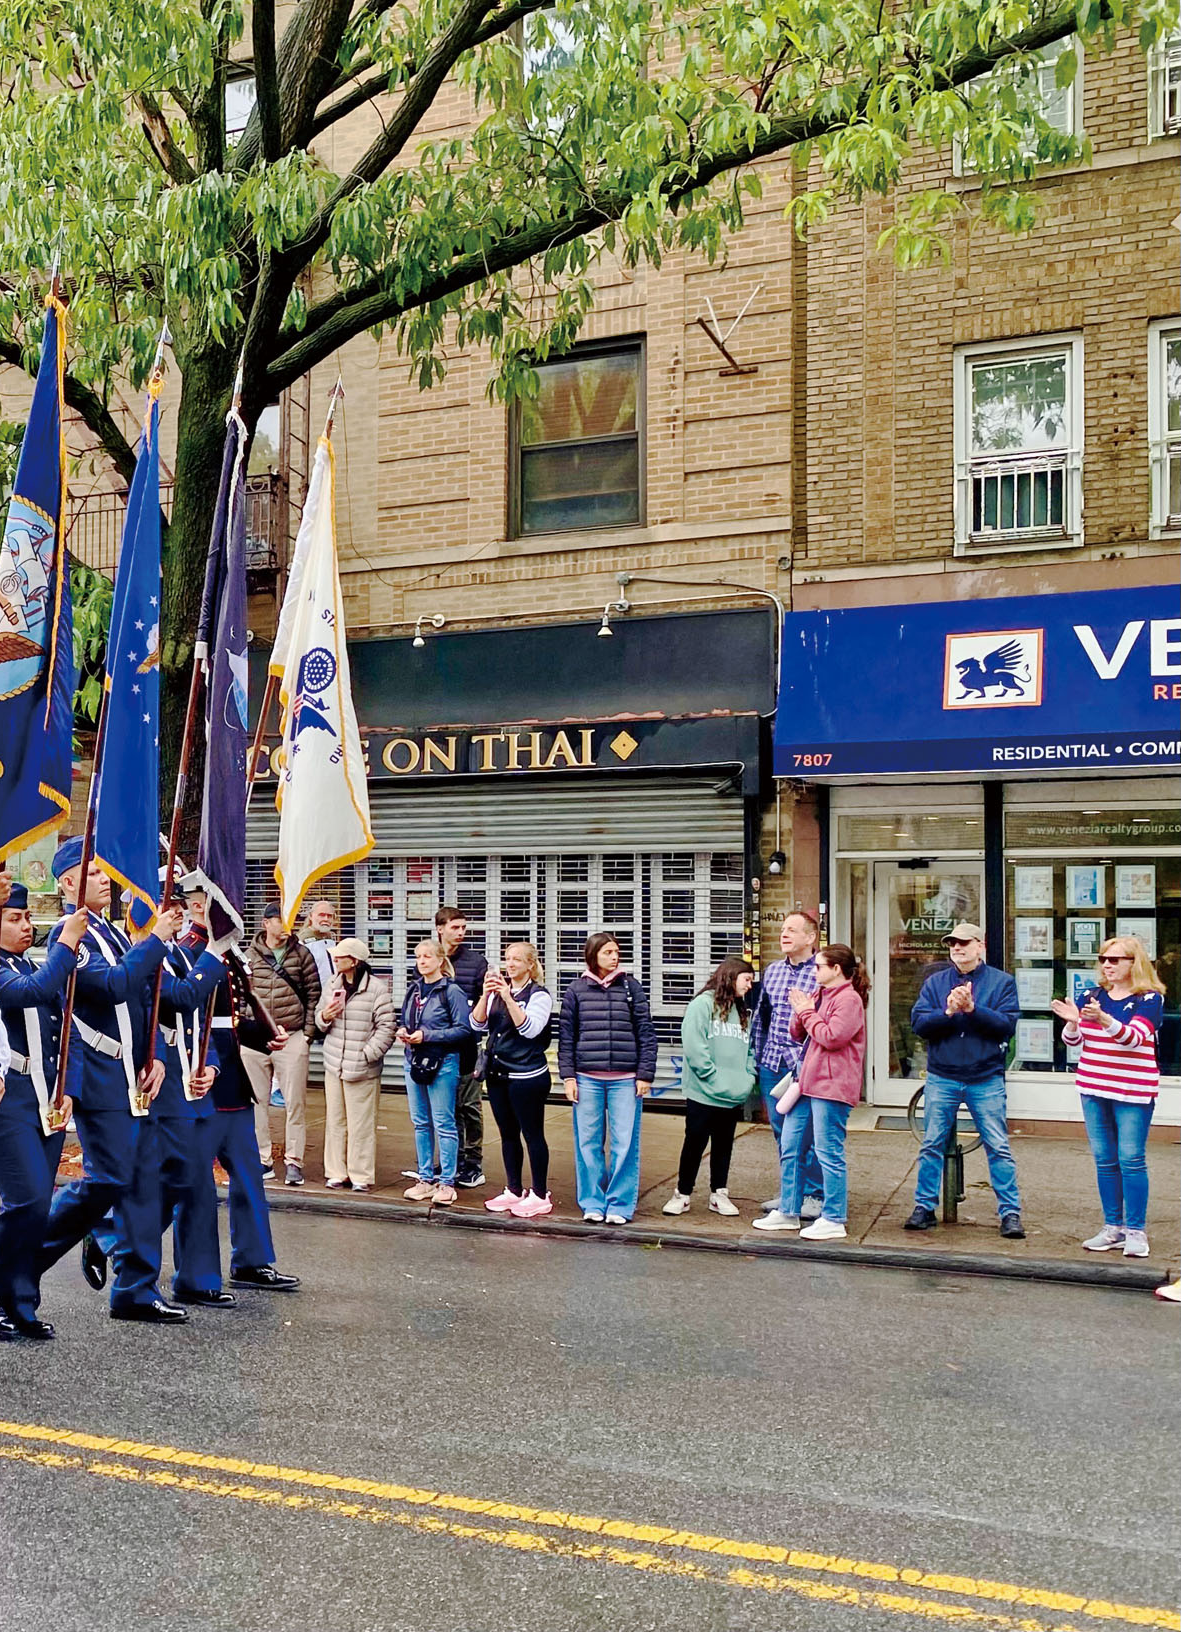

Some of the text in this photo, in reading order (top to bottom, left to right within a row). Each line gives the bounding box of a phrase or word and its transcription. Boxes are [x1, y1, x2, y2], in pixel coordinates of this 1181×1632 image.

[382, 736, 458, 774] ON
[471, 729, 597, 771] THAI
[792, 753, 833, 767] 7807
[992, 743, 1111, 761] RESIDENTIAL
